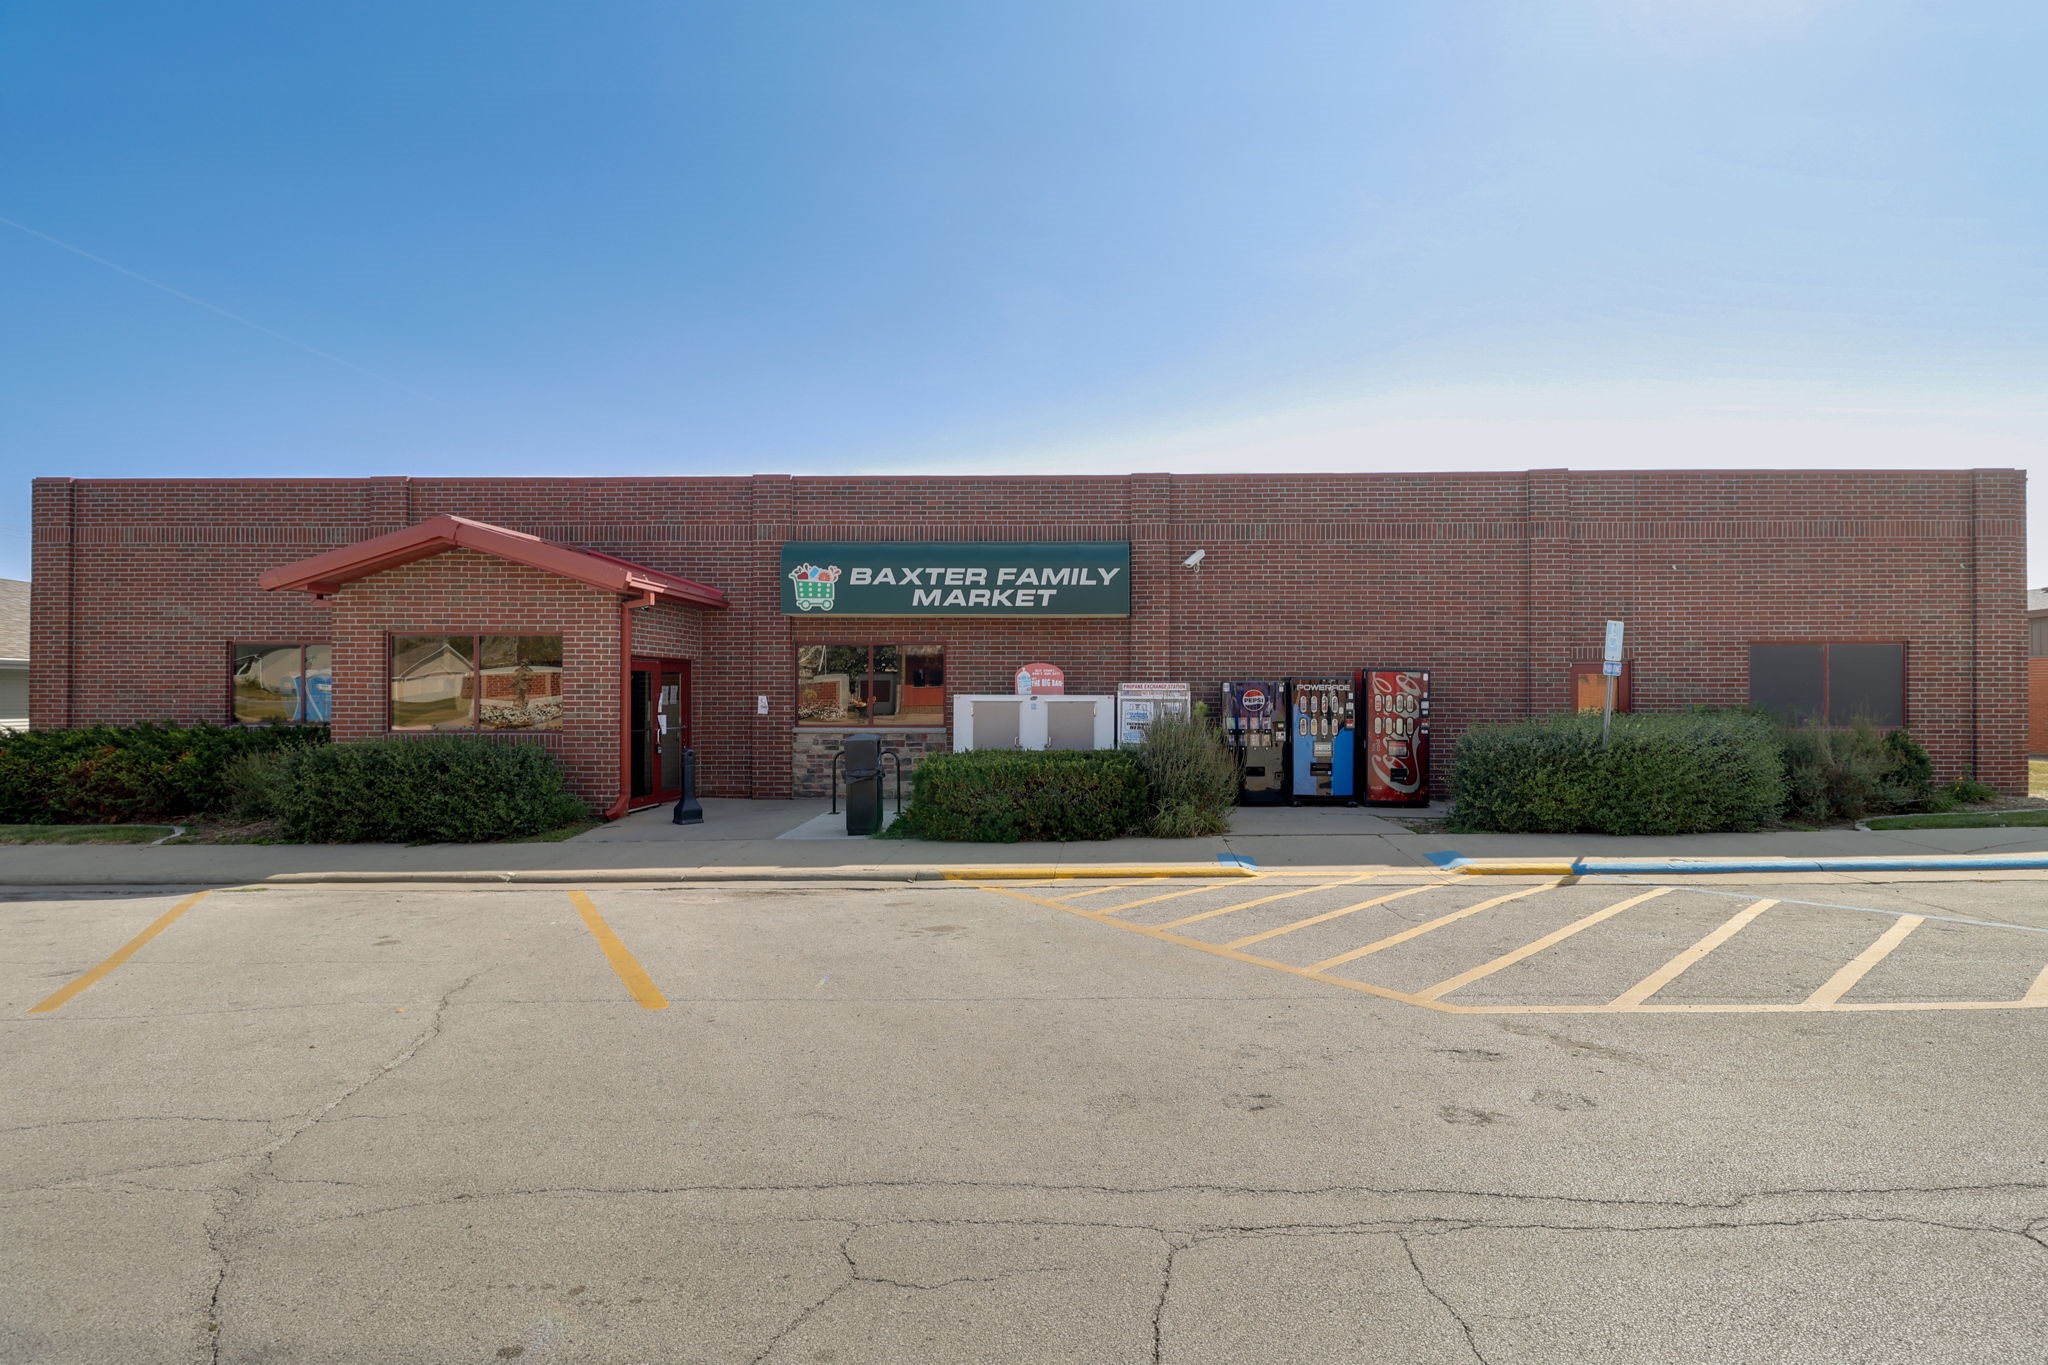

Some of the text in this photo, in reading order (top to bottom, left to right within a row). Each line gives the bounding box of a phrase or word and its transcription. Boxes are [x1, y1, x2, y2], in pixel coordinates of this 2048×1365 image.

[849, 567, 1121, 586] BAXTER FAMILY
[911, 588, 1057, 607] MARKET
